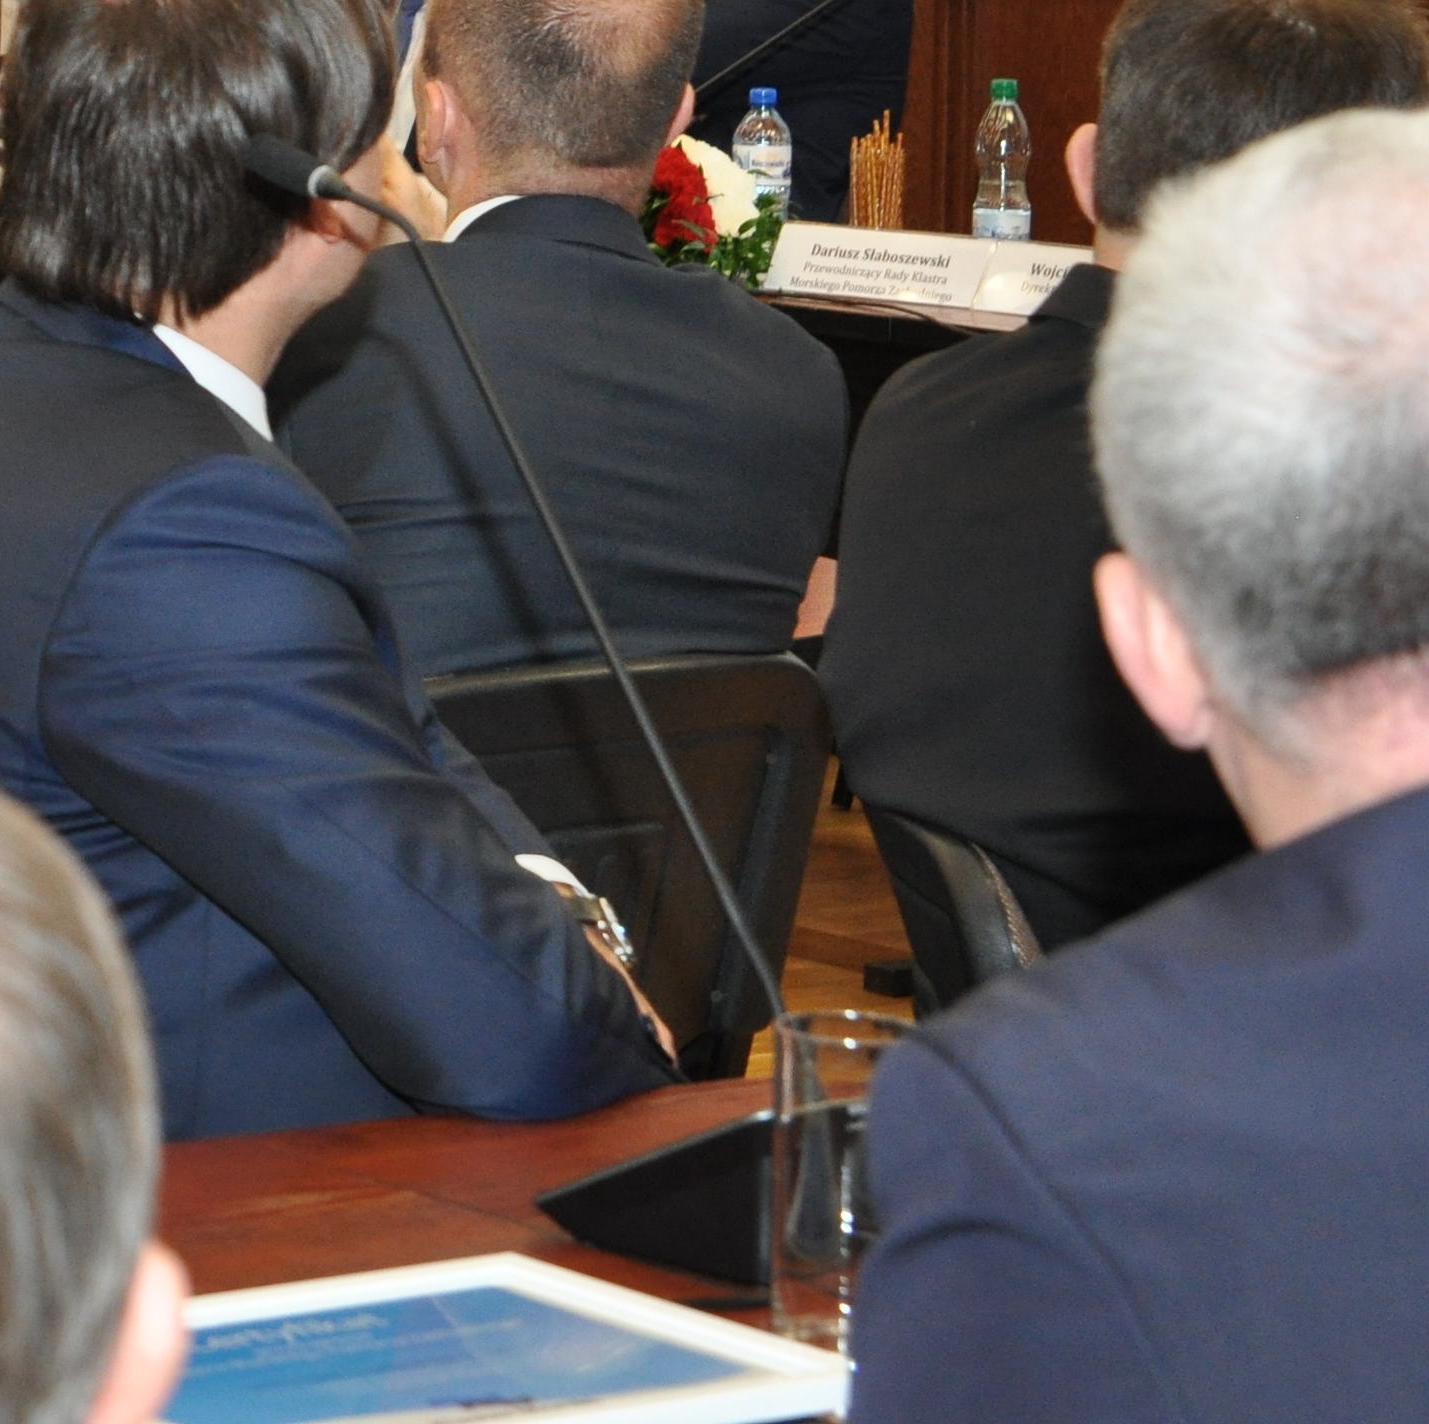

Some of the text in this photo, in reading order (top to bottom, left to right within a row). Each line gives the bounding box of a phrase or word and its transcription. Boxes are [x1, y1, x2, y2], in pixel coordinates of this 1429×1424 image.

[811, 243, 952, 269] Dariusz Słaboszewski
[790, 275, 841, 291] Morskiego
[842, 280, 886, 295] Pomorza
[803, 261, 947, 285] Przewodniczący Rady Klastra
